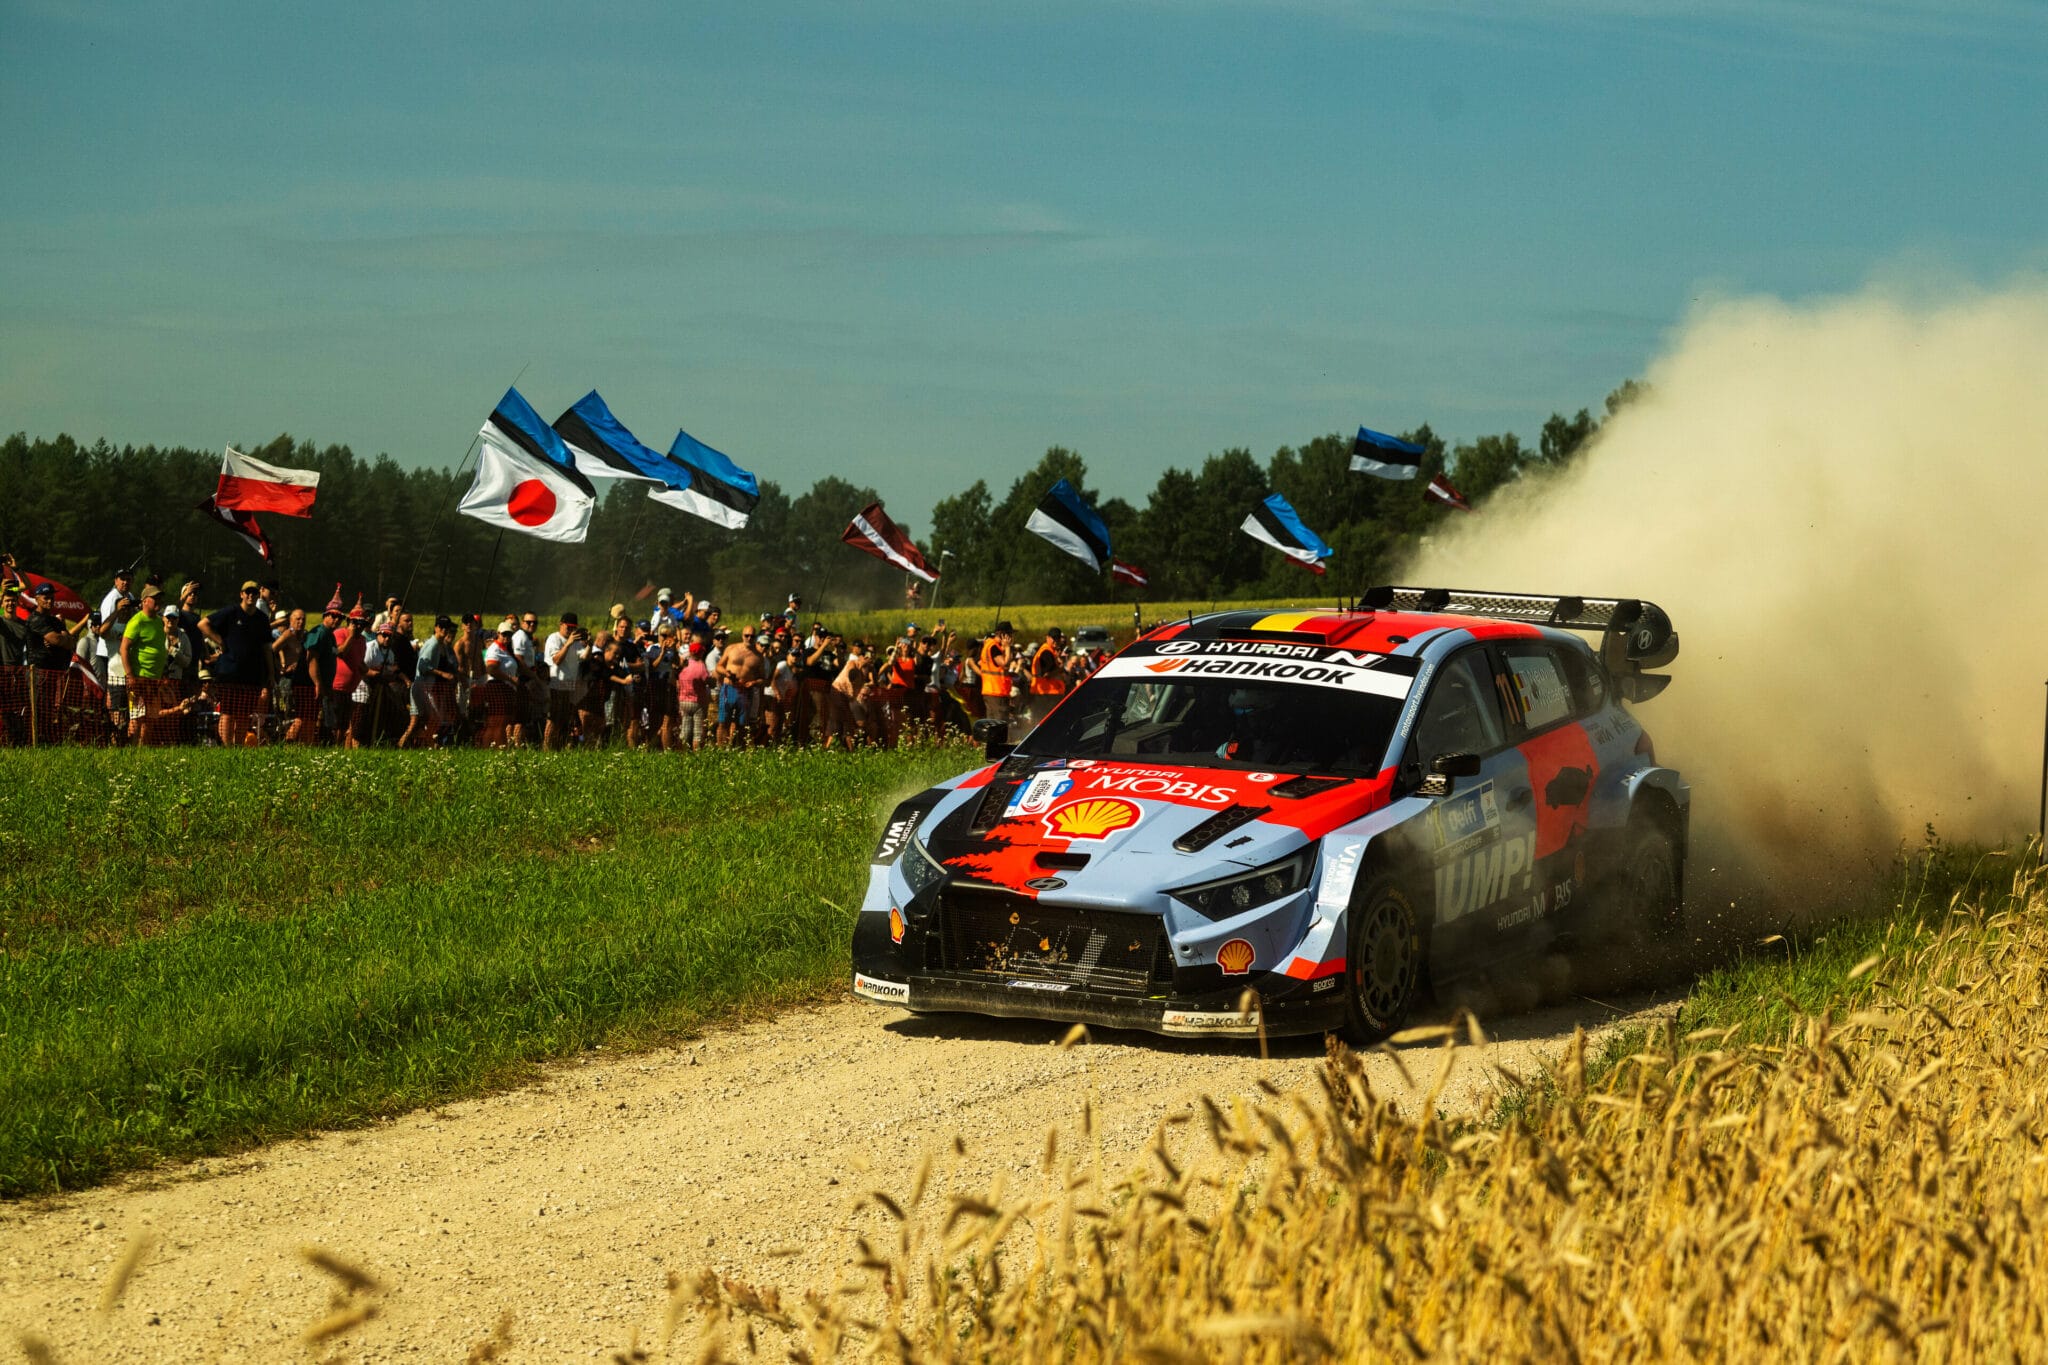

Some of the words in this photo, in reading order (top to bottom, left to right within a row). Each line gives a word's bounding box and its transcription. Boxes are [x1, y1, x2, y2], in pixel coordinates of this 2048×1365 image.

[1205, 641, 1318, 659] HYUNDAI
[1084, 766, 1184, 779] HYUNDAI
[1085, 775, 1238, 804] MOBIS
[900, 810, 921, 842] HYUNDAI
[1497, 905, 1531, 932] HYUNDAI
[1313, 977, 1335, 993] sparco
